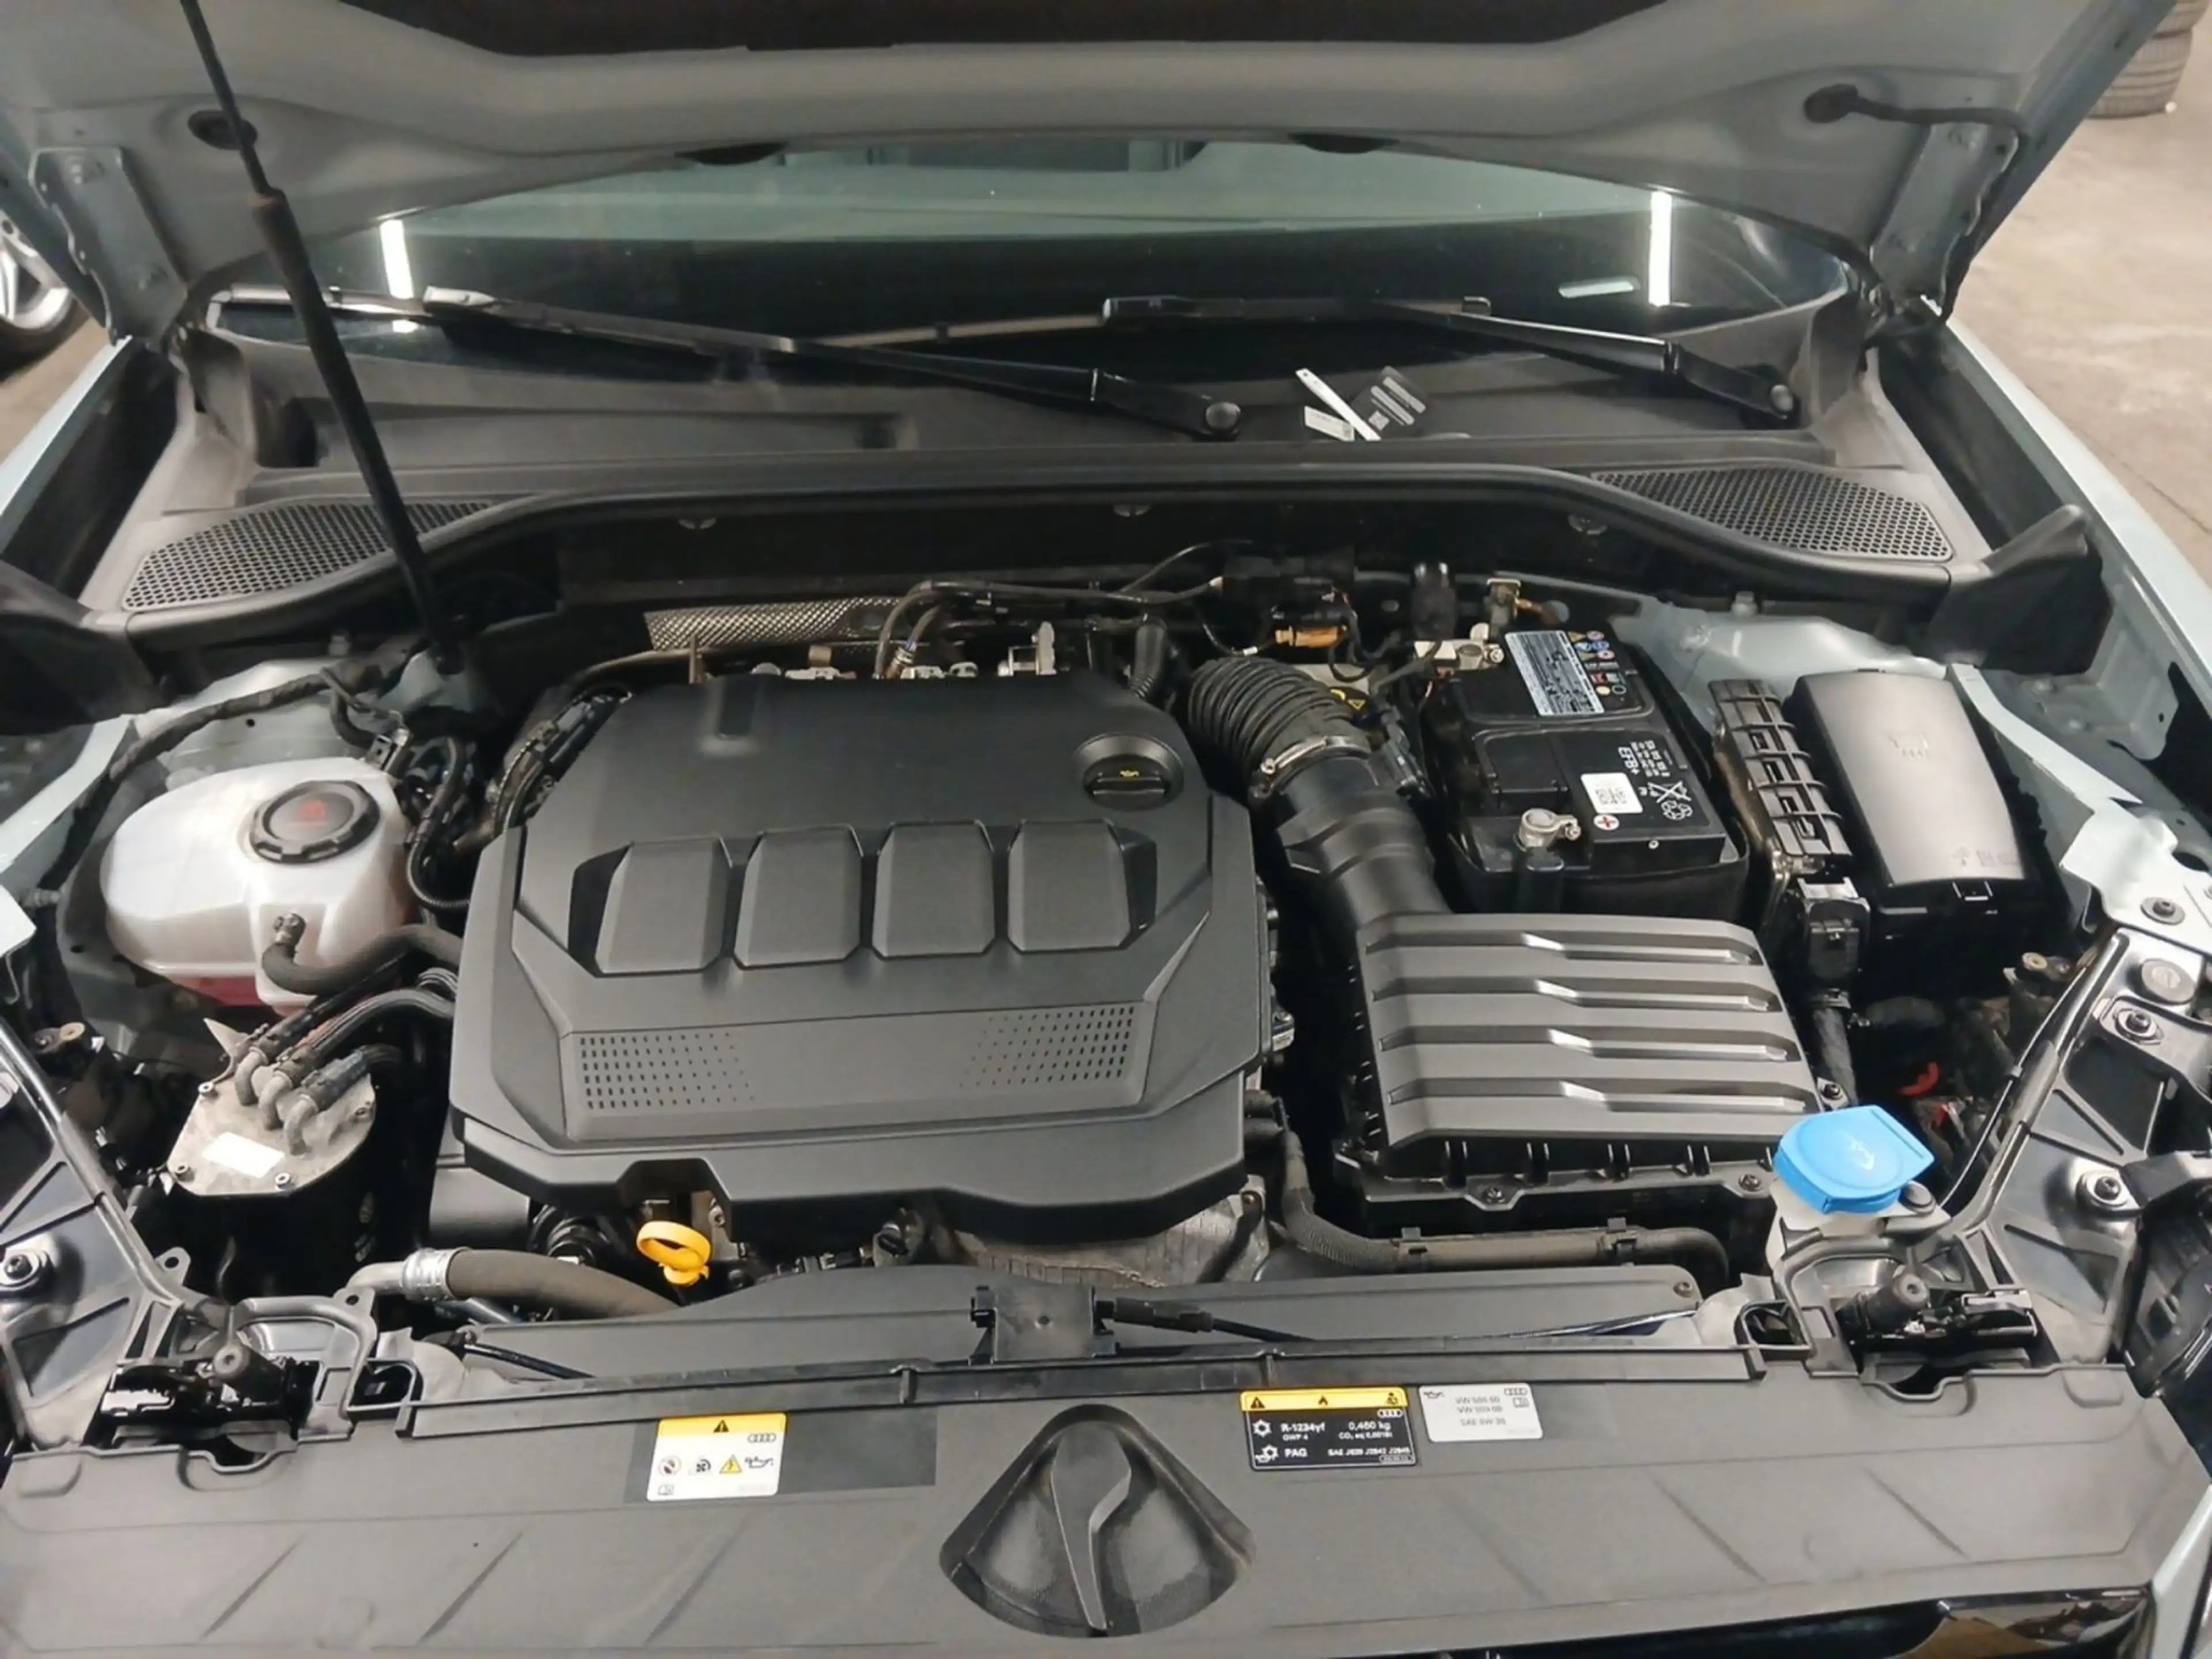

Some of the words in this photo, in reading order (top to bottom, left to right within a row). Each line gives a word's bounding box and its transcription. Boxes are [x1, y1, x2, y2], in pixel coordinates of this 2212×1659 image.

[1281, 1422, 1325, 1433] R-1234yf
[1378, 1421, 1391, 1431] kg
[1284, 1447, 1308, 1459] PAG
